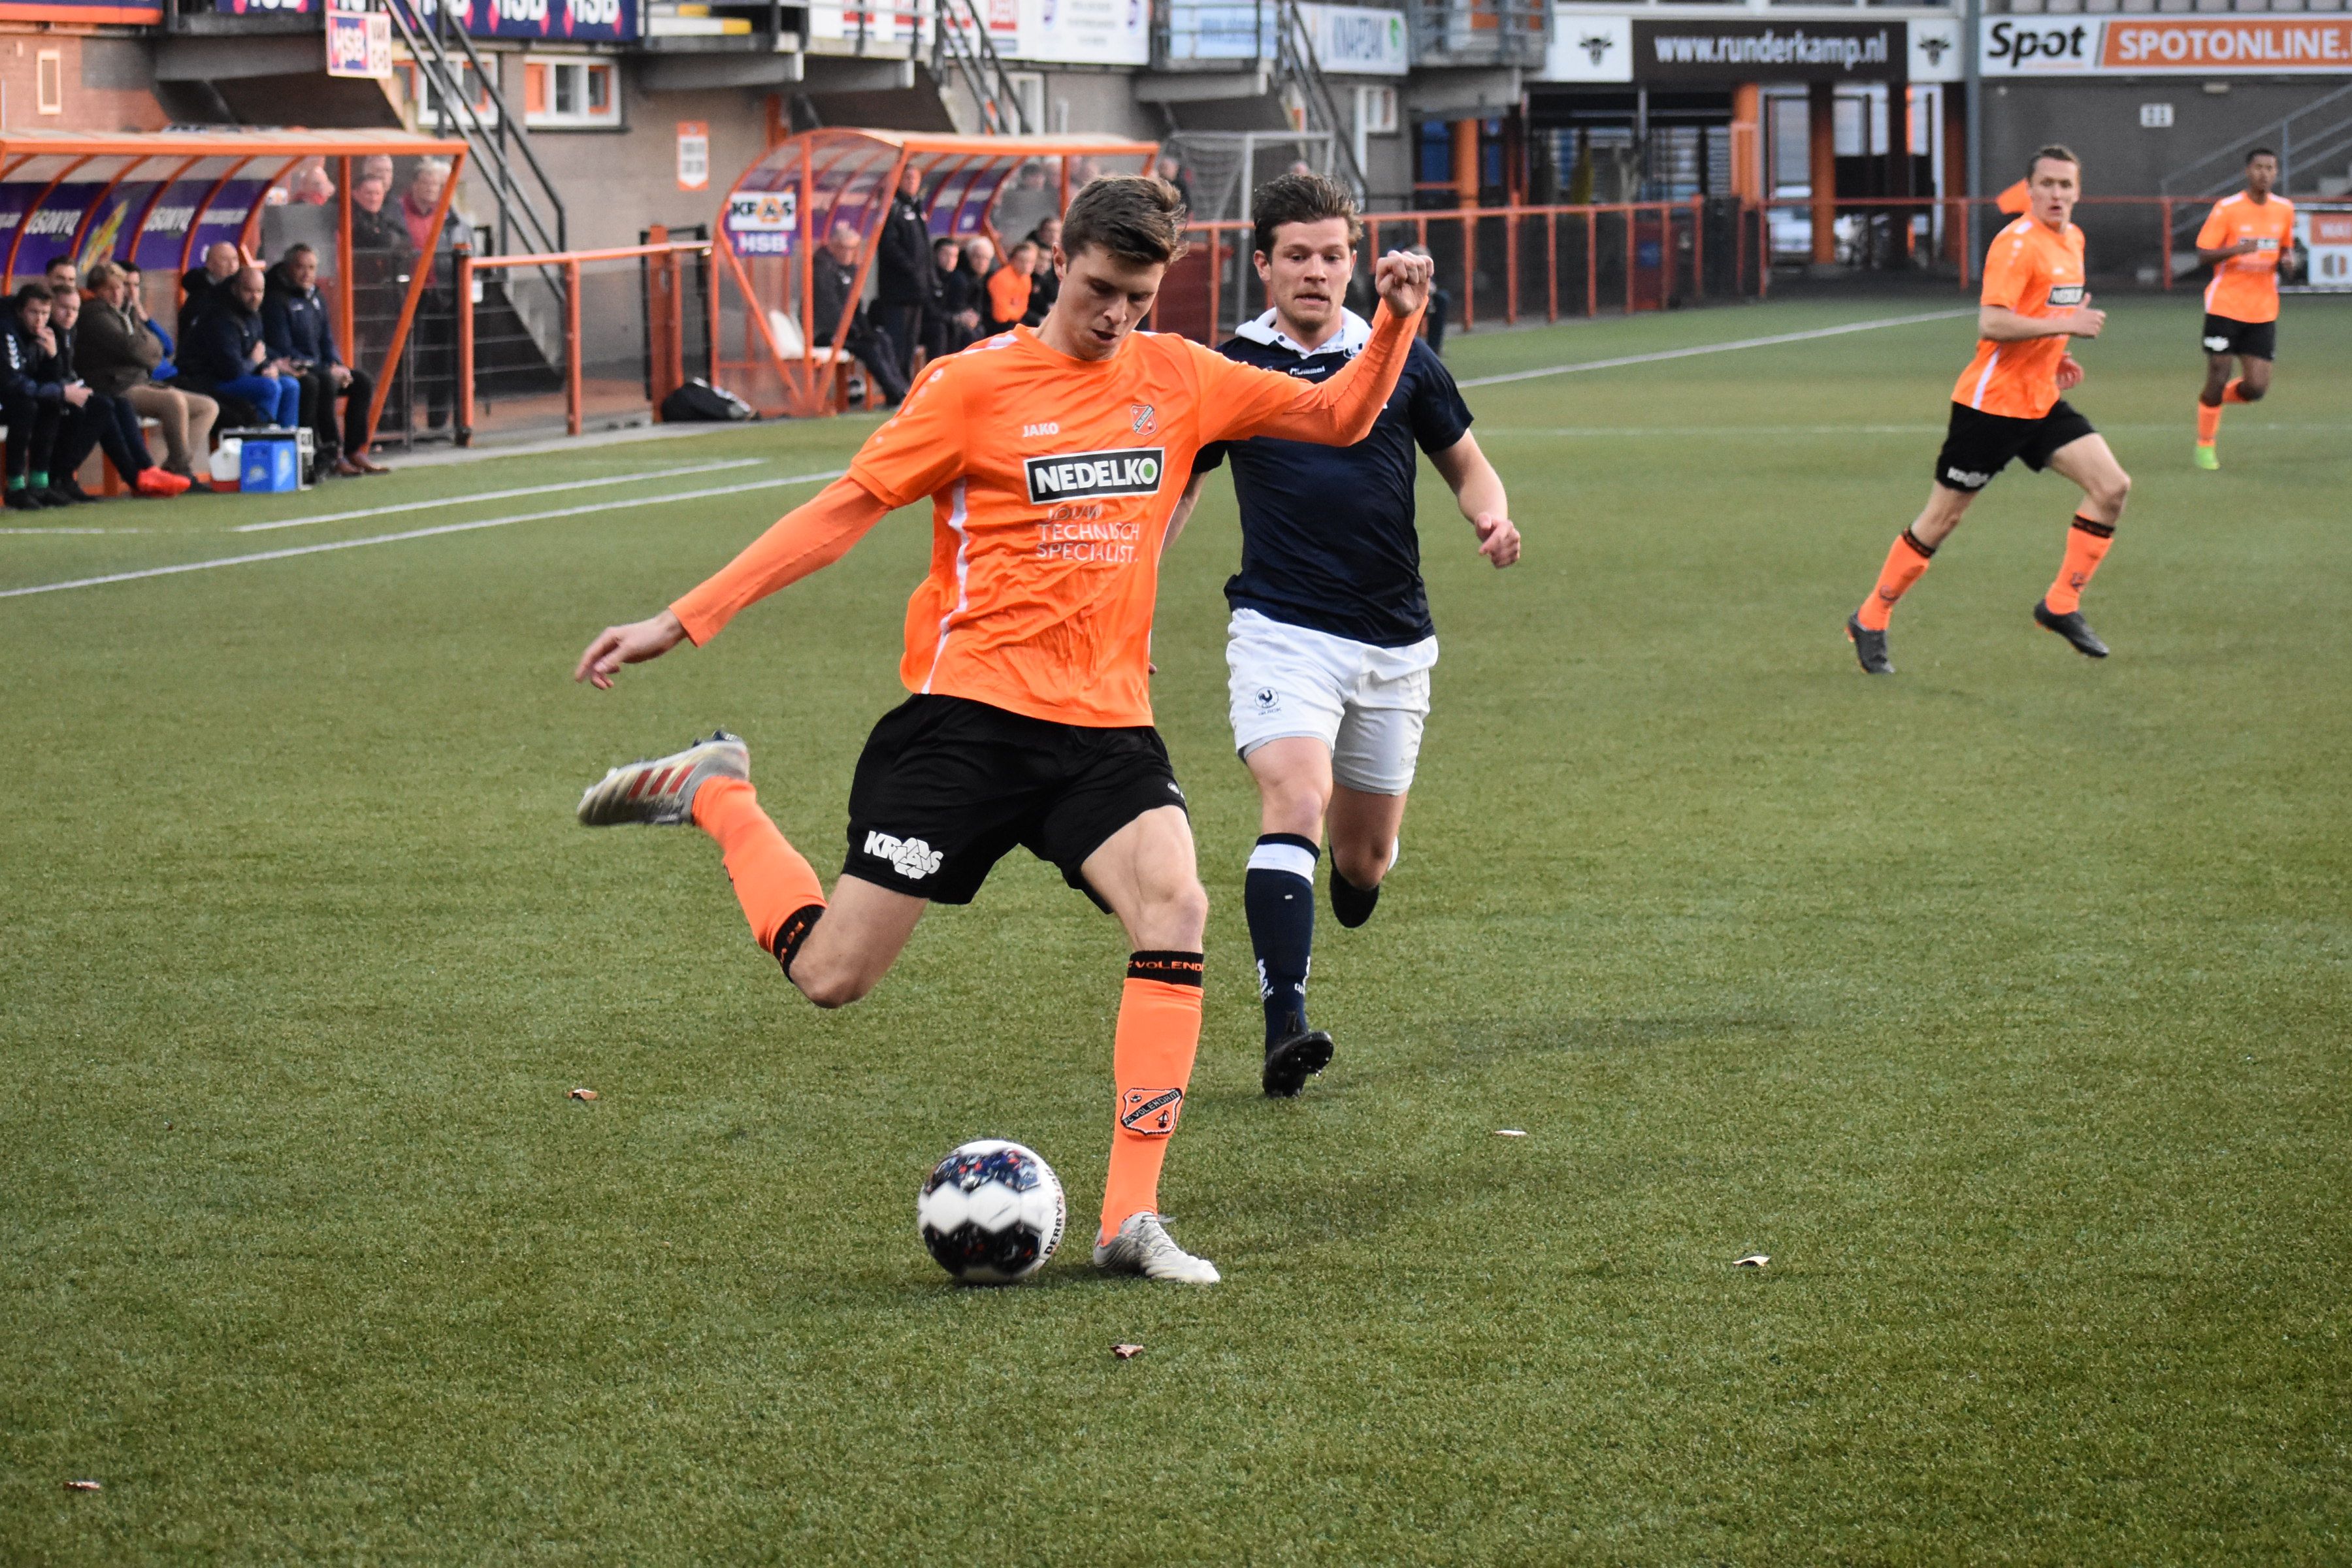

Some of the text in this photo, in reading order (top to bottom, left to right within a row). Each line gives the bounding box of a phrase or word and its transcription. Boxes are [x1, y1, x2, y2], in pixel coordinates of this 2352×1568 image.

[1654, 28, 1887, 71] www.runderkamp.nl
[1988, 22, 2086, 68] Spot
[2118, 29, 2352, 59] SPOTONLINE.
[739, 233, 788, 252] HSB
[1023, 423, 1059, 437] JAKO
[1035, 457, 1158, 493] NEDELKO
[1036, 523, 1139, 541] TECHNISCH
[864, 830, 943, 874] KRAS
[1123, 1090, 1179, 1125] FC VOLENDAM
